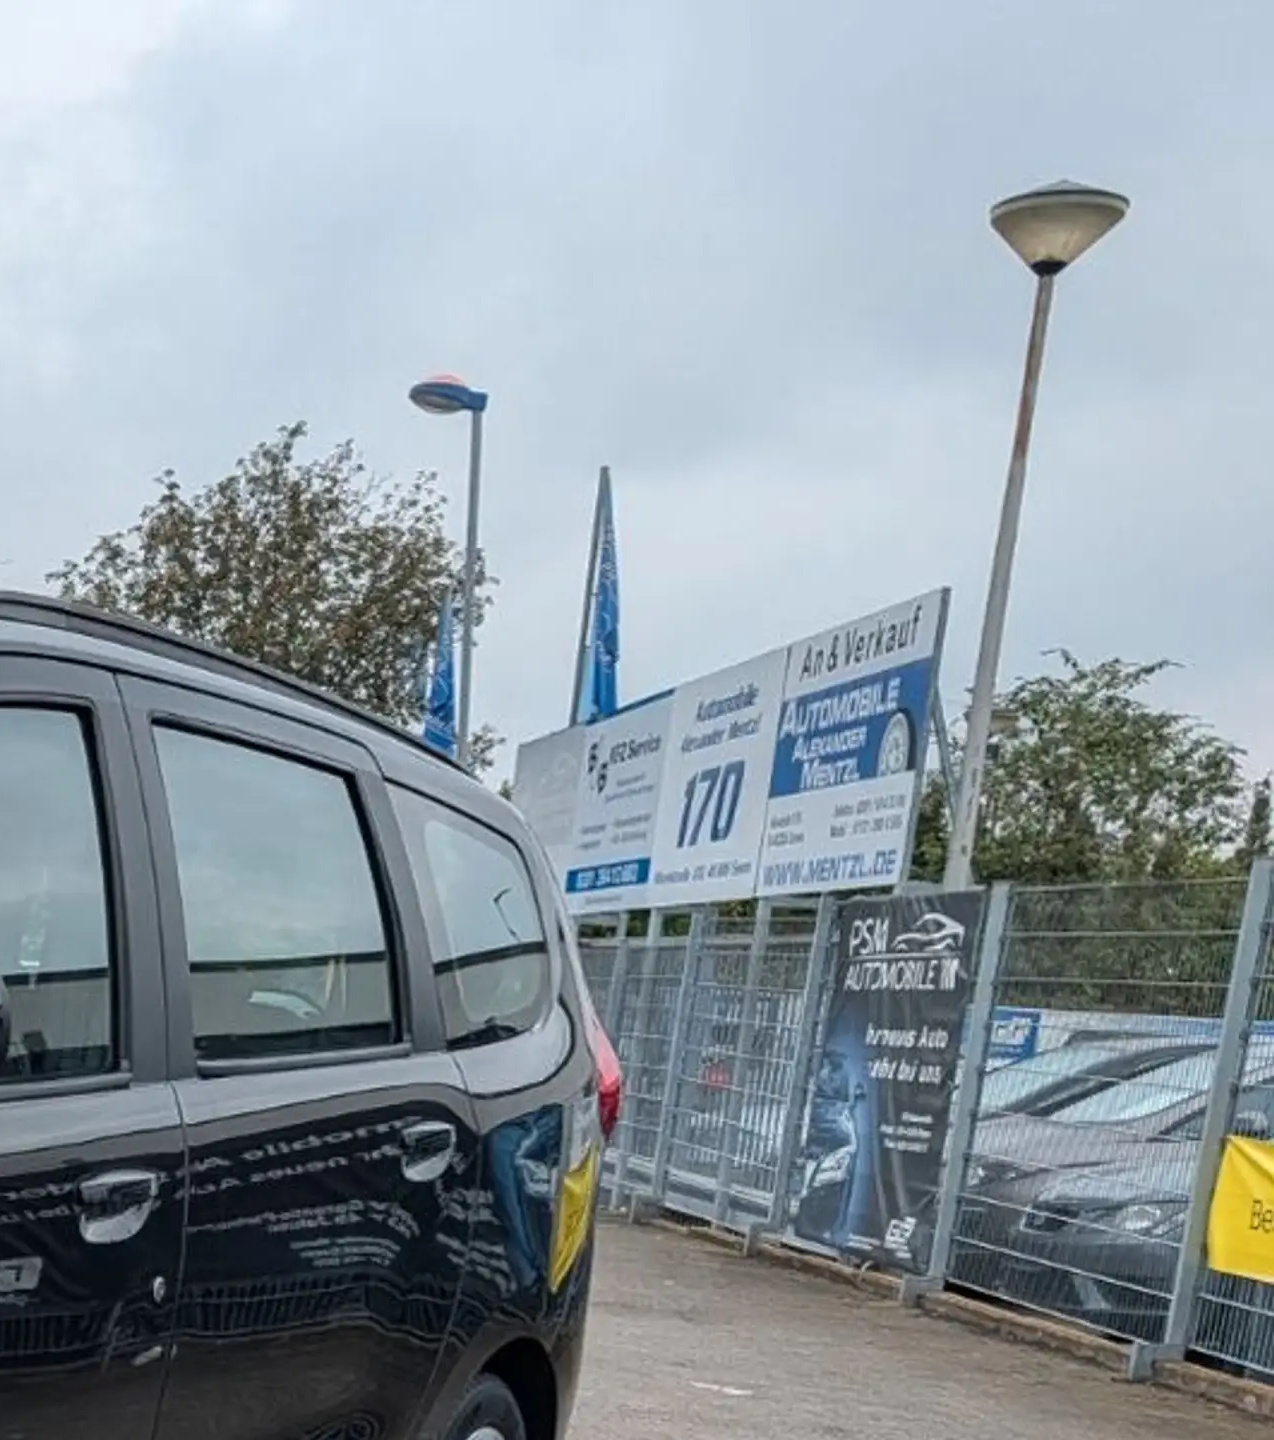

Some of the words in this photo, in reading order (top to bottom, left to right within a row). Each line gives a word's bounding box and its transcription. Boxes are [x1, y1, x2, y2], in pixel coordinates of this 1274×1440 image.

[799, 644, 824, 682] An
[826, 633, 839, 673] &
[844, 604, 923, 667] Verkauf
[779, 677, 901, 740] AUTOMOBILE
[792, 725, 868, 762] ALEXANDER
[800, 758, 860, 789] MENTZL
[676, 760, 745, 848] 170
[763, 849, 898, 888] WWW.MENTZL.DE
[849, 917, 889, 956] PSM
[843, 960, 938, 991] AUTOMOBILE
